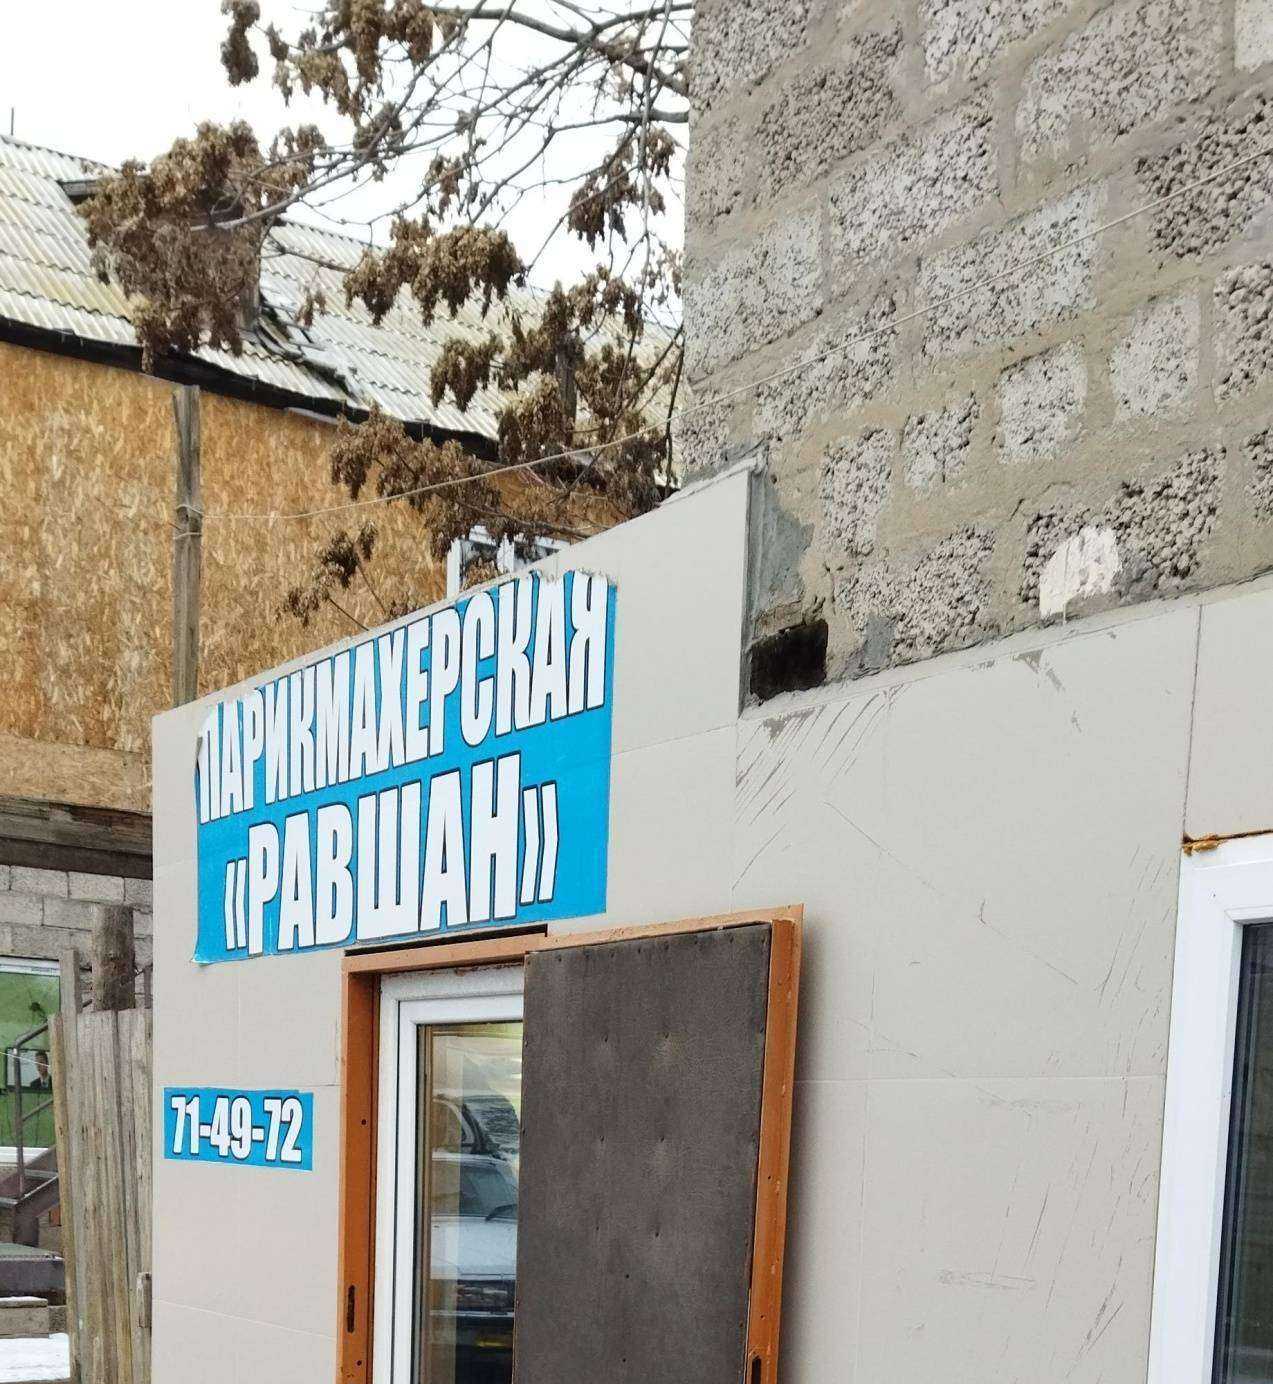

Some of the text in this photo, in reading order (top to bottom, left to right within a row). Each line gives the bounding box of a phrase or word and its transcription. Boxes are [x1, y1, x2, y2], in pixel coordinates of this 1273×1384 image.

[198, 571, 608, 825] ПАРИКМАХЕРСКАЯ
[224, 751, 559, 957] «РАВШАН»
[170, 1095, 304, 1163] 71-49-72
